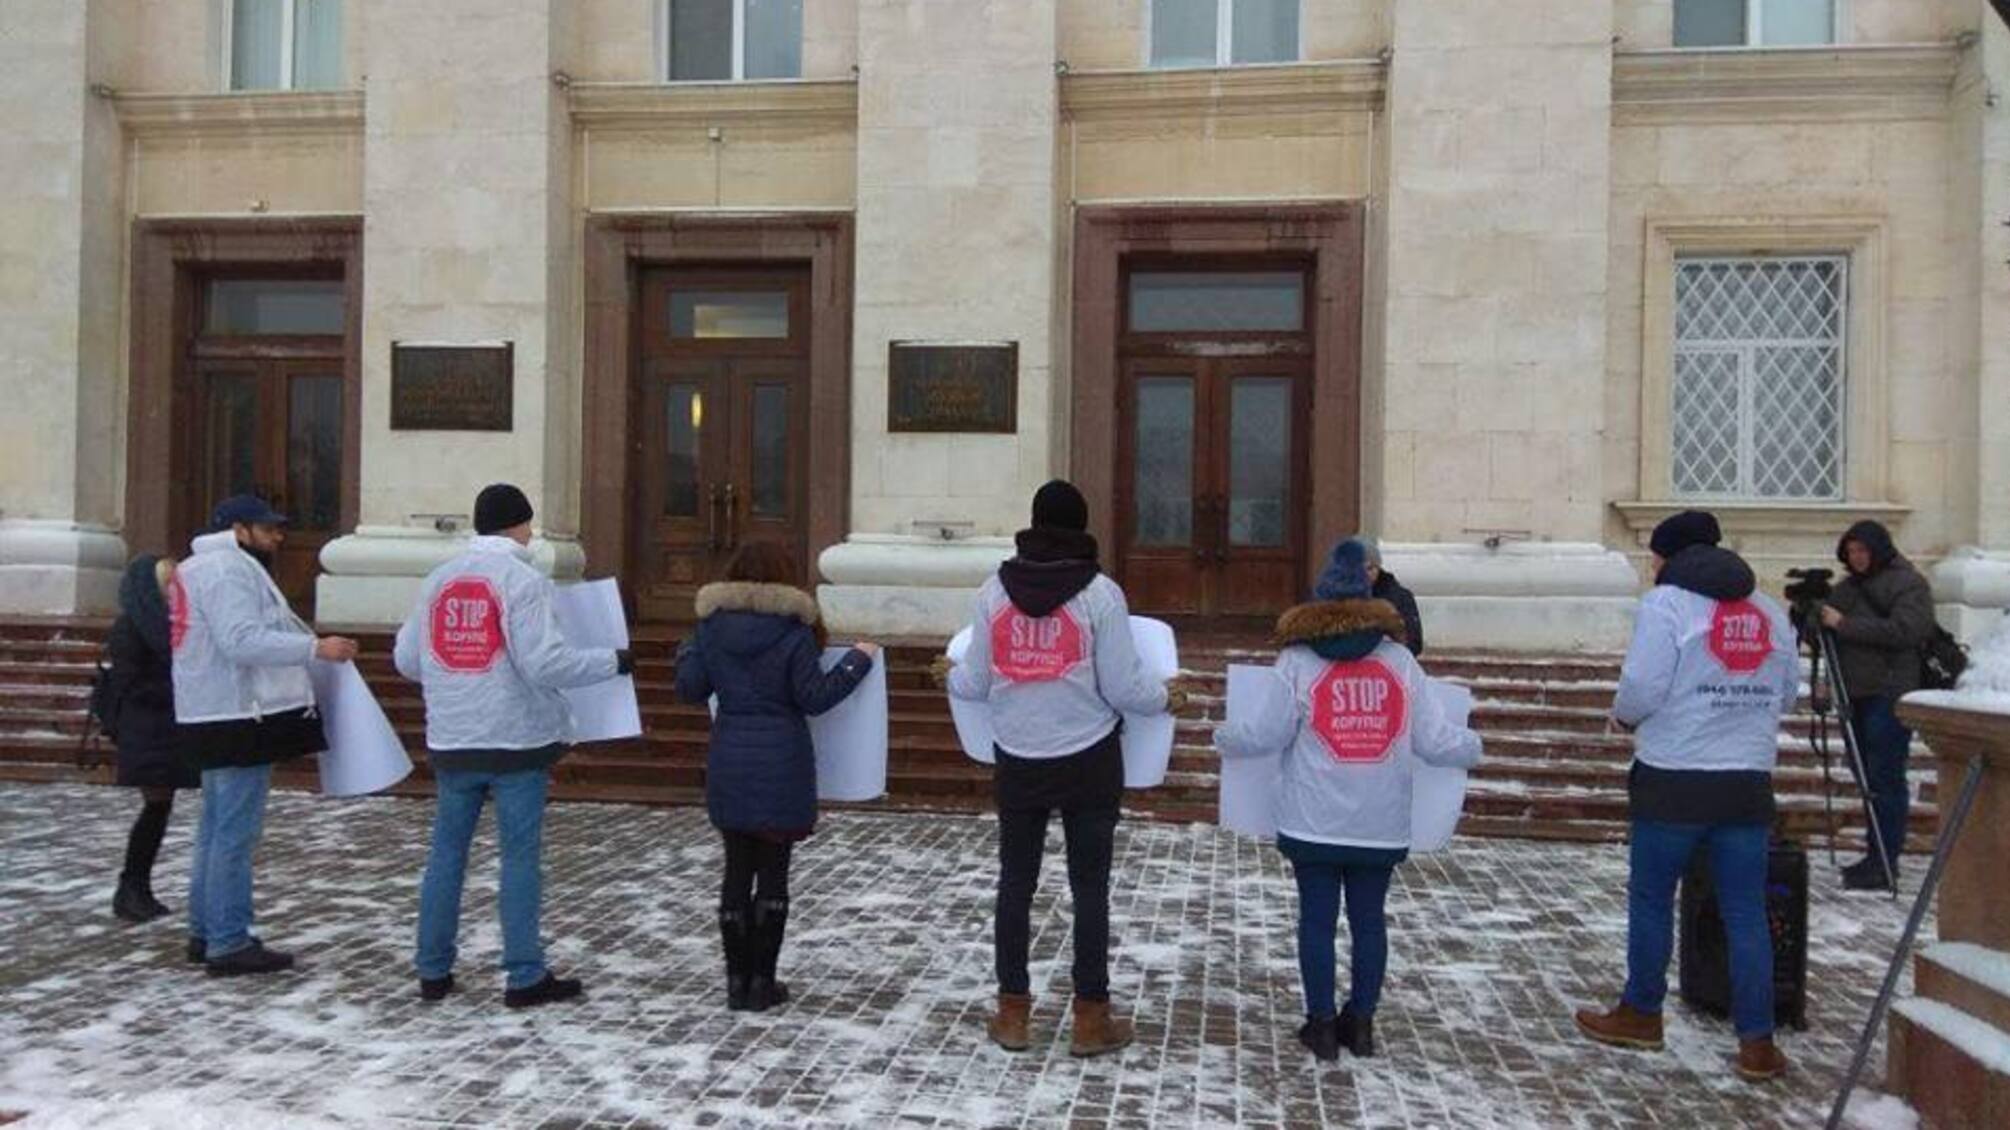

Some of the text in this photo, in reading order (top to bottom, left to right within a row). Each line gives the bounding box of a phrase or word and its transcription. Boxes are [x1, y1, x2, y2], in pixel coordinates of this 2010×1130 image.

[444, 597, 489, 628] STOP
[1010, 615, 1061, 649] STOP
[1332, 677, 1388, 712] STOP
